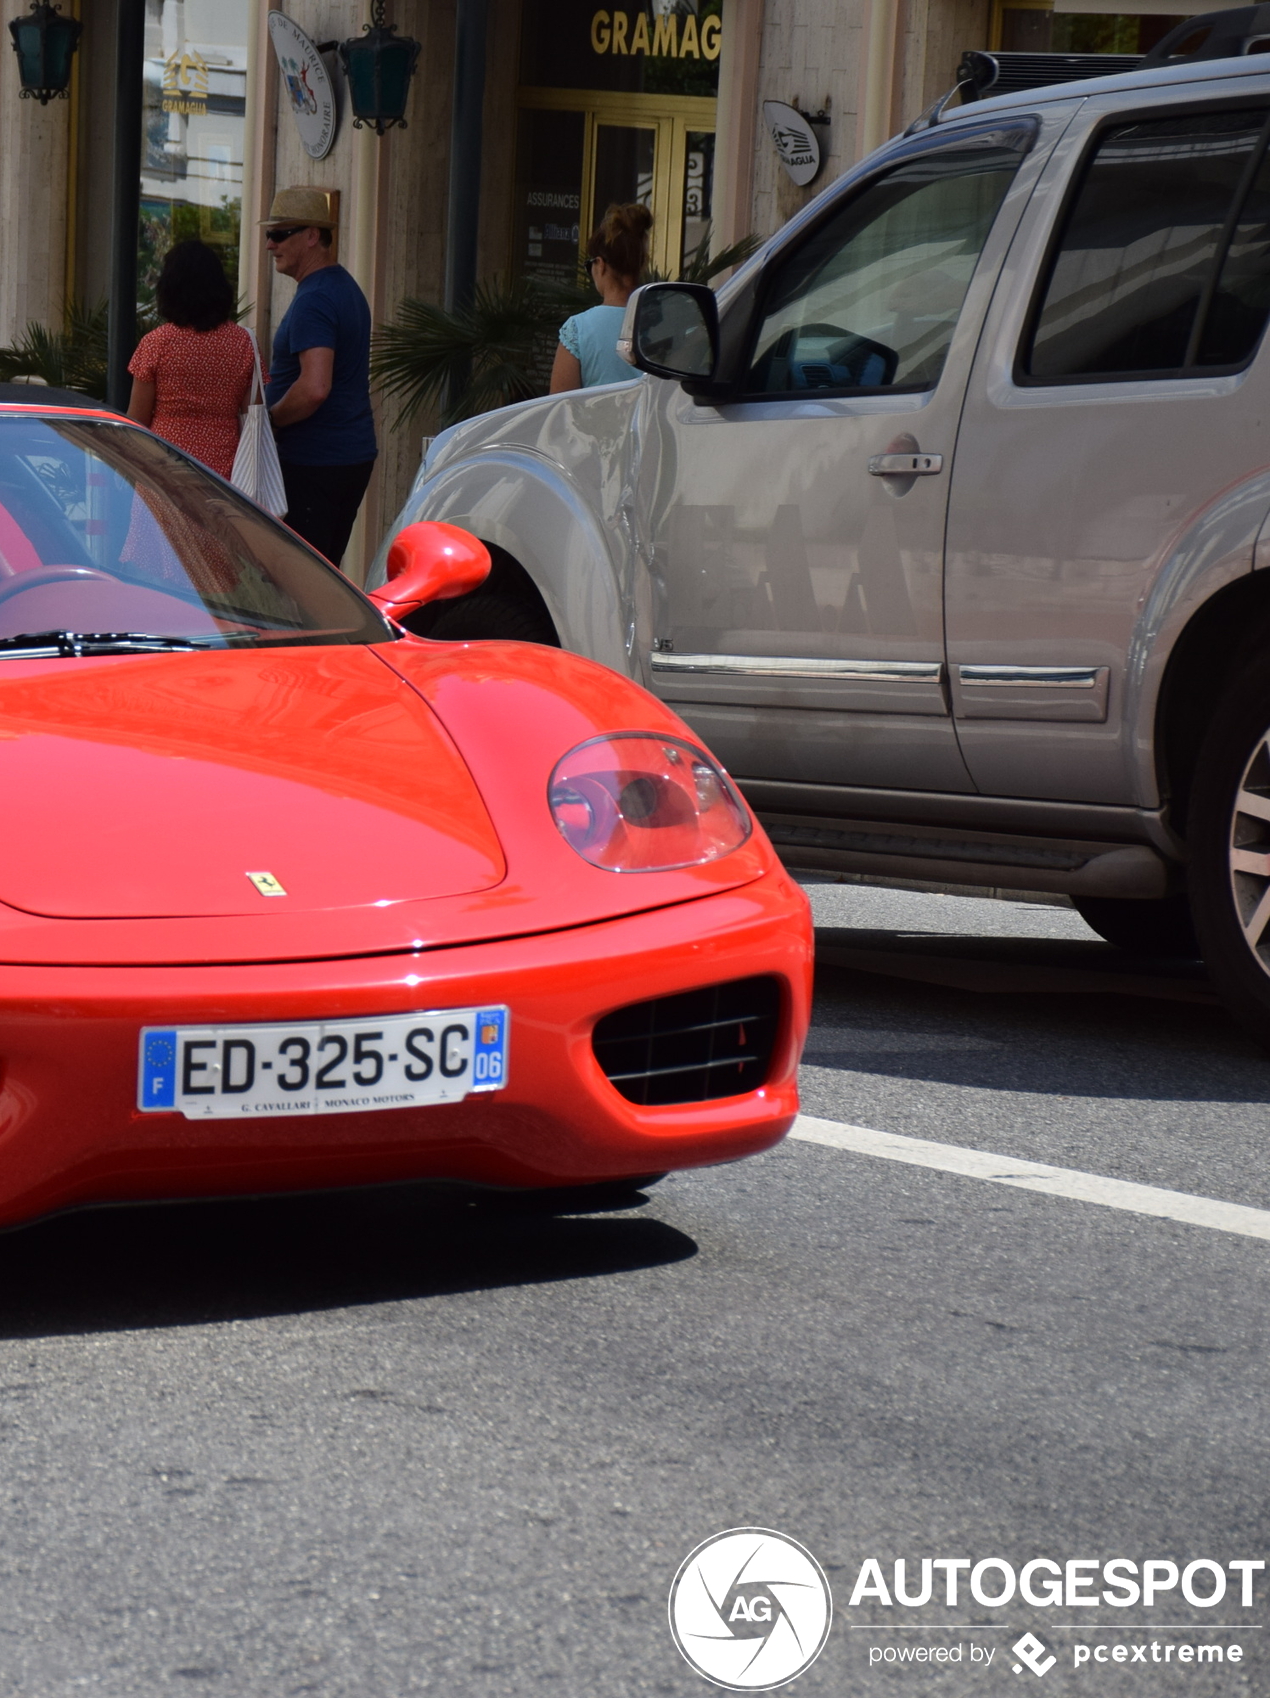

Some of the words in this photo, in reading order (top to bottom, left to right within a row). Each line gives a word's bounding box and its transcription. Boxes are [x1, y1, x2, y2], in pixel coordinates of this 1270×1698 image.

[590, 9, 722, 61] GRAMAG
[292, 28, 326, 83] MAURICE
[162, 99, 207, 116] GRAMAGLIA
[527, 192, 580, 209] ASSURANCES
[182, 1024, 470, 1095] ED-325-SC
[475, 1051, 502, 1079] 06
[152, 1077, 164, 1095] F
[241, 1104, 252, 1112] G.
[255, 1102, 311, 1112] CAVALLARI
[324, 1096, 370, 1108] MONACO
[372, 1093, 415, 1104] MOTORS
